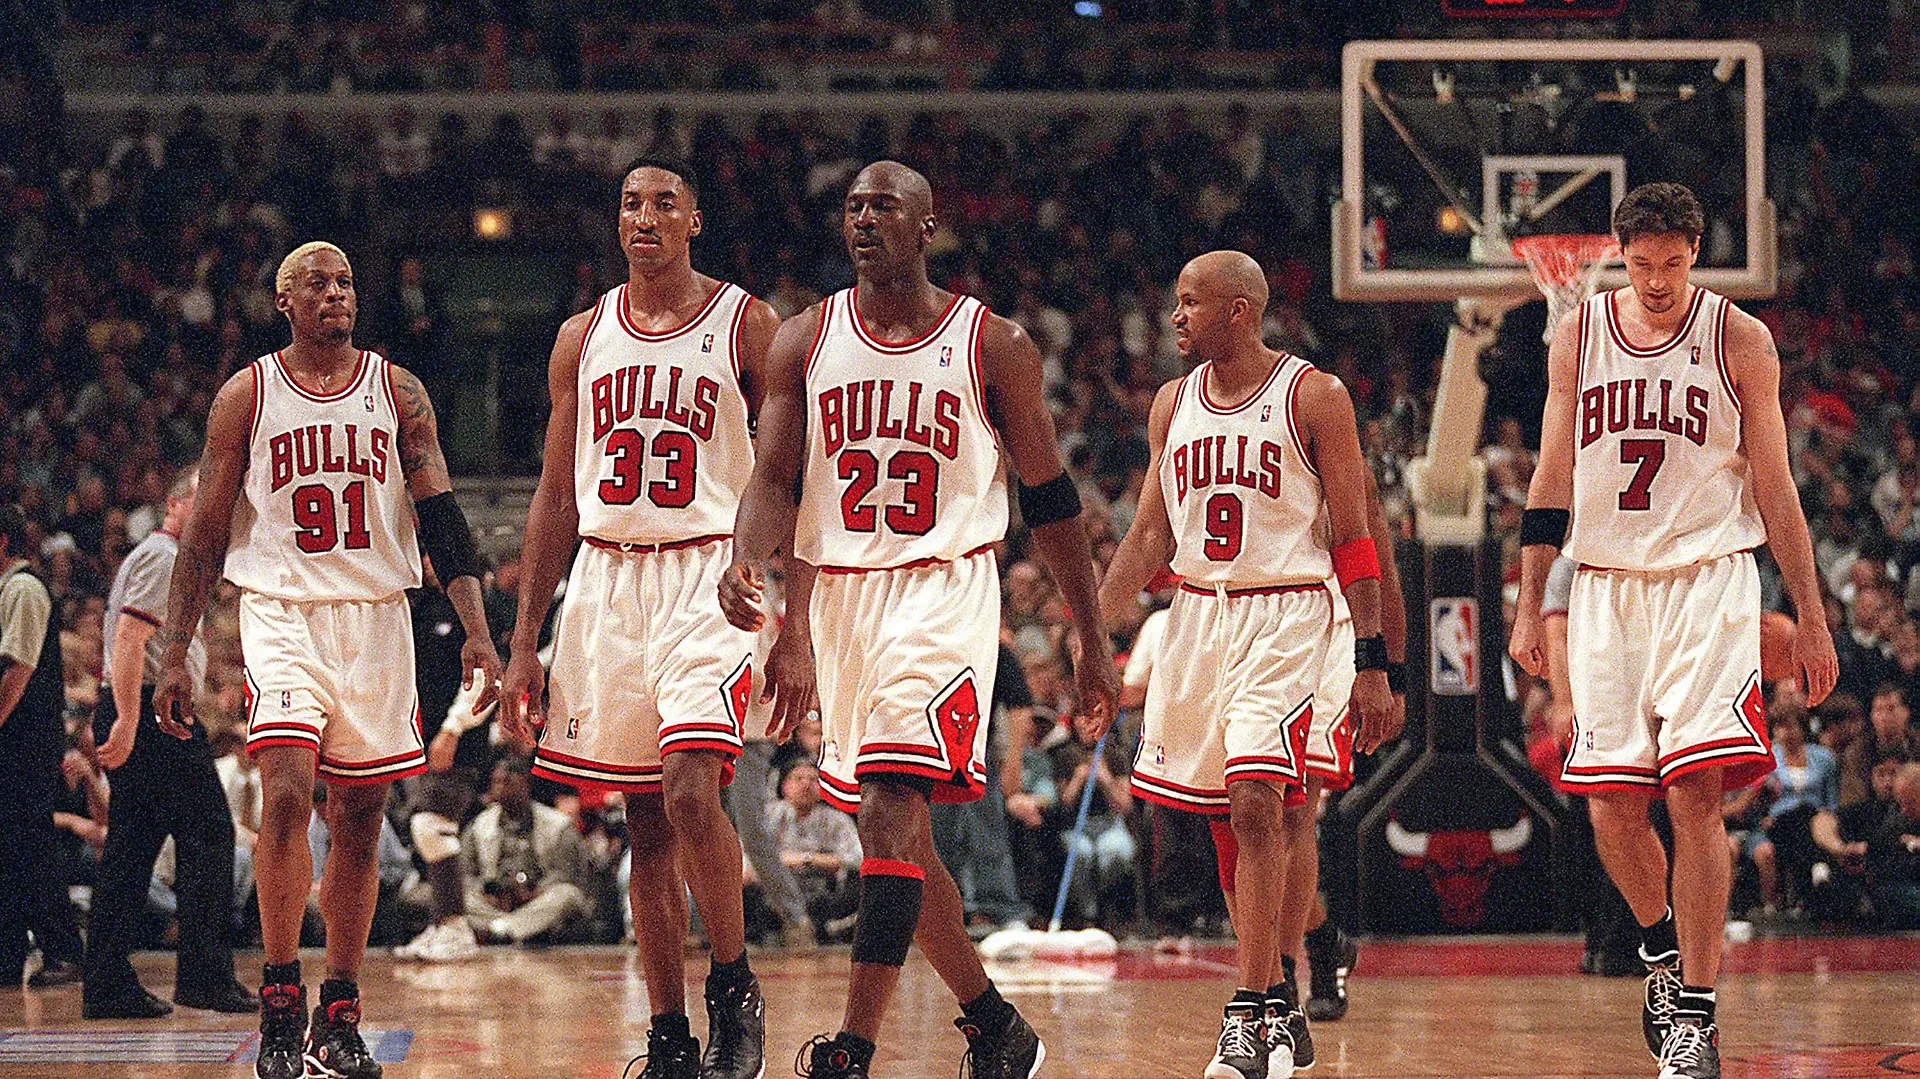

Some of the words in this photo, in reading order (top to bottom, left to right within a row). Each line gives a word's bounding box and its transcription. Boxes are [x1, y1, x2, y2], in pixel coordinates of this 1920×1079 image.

[592, 365, 720, 444] BULLS
[818, 379, 961, 460] BULLS
[1581, 379, 1709, 450] BULLS
[270, 424, 389, 493] BULLS
[598, 428, 697, 509] 33
[837, 449, 939, 536] 23
[1173, 435, 1281, 507] BULLS
[1619, 439, 1665, 511] 7
[292, 481, 371, 554] 91
[1203, 493, 1243, 561] 9
